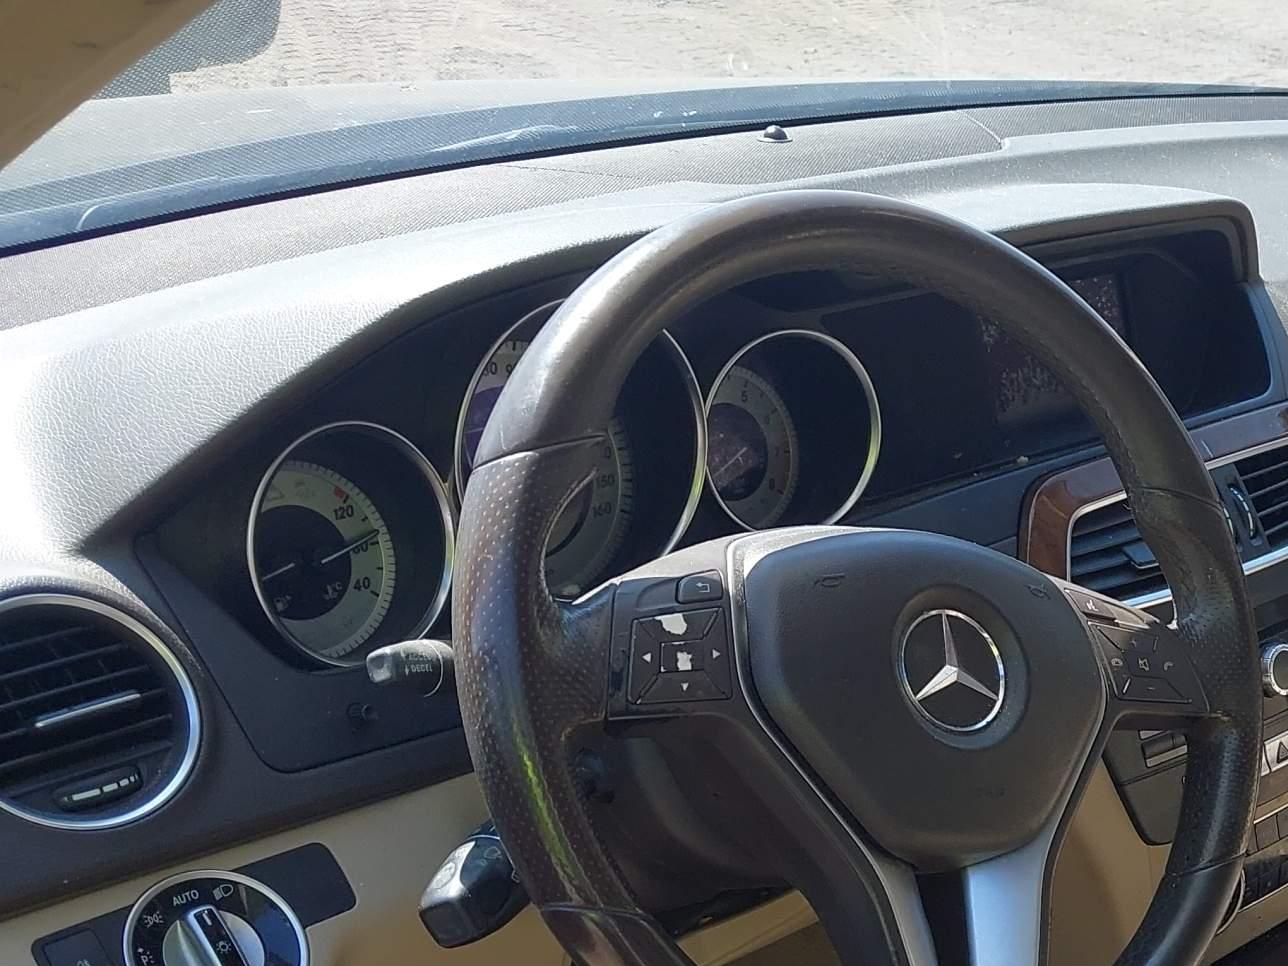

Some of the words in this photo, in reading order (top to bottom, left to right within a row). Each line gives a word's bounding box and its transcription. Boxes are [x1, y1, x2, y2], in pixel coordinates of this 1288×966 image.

[333, 505, 354, 521] 120
[353, 576, 371, 591] 40
[410, 663, 433, 673] DECEL
[172, 889, 200, 907] AUTO
